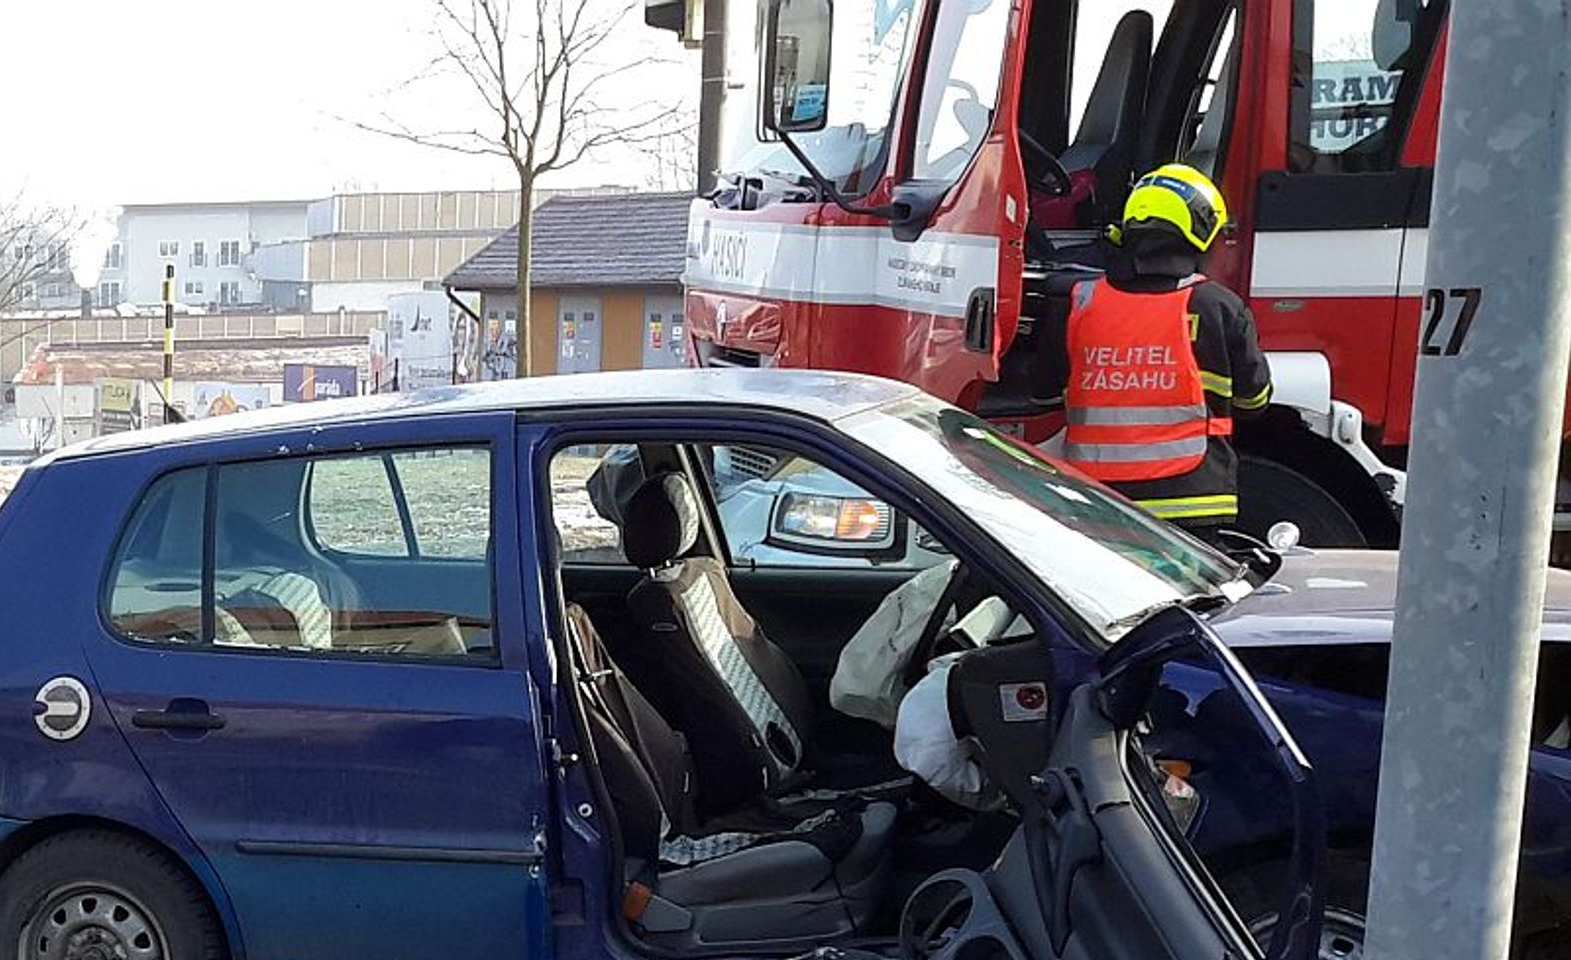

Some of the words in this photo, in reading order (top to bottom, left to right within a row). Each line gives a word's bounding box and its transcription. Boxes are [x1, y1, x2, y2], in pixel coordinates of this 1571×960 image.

[1421, 288, 1482, 356] 27
[1084, 346, 1178, 366] VELITEL
[1081, 369, 1177, 390] ZÁSAHU
